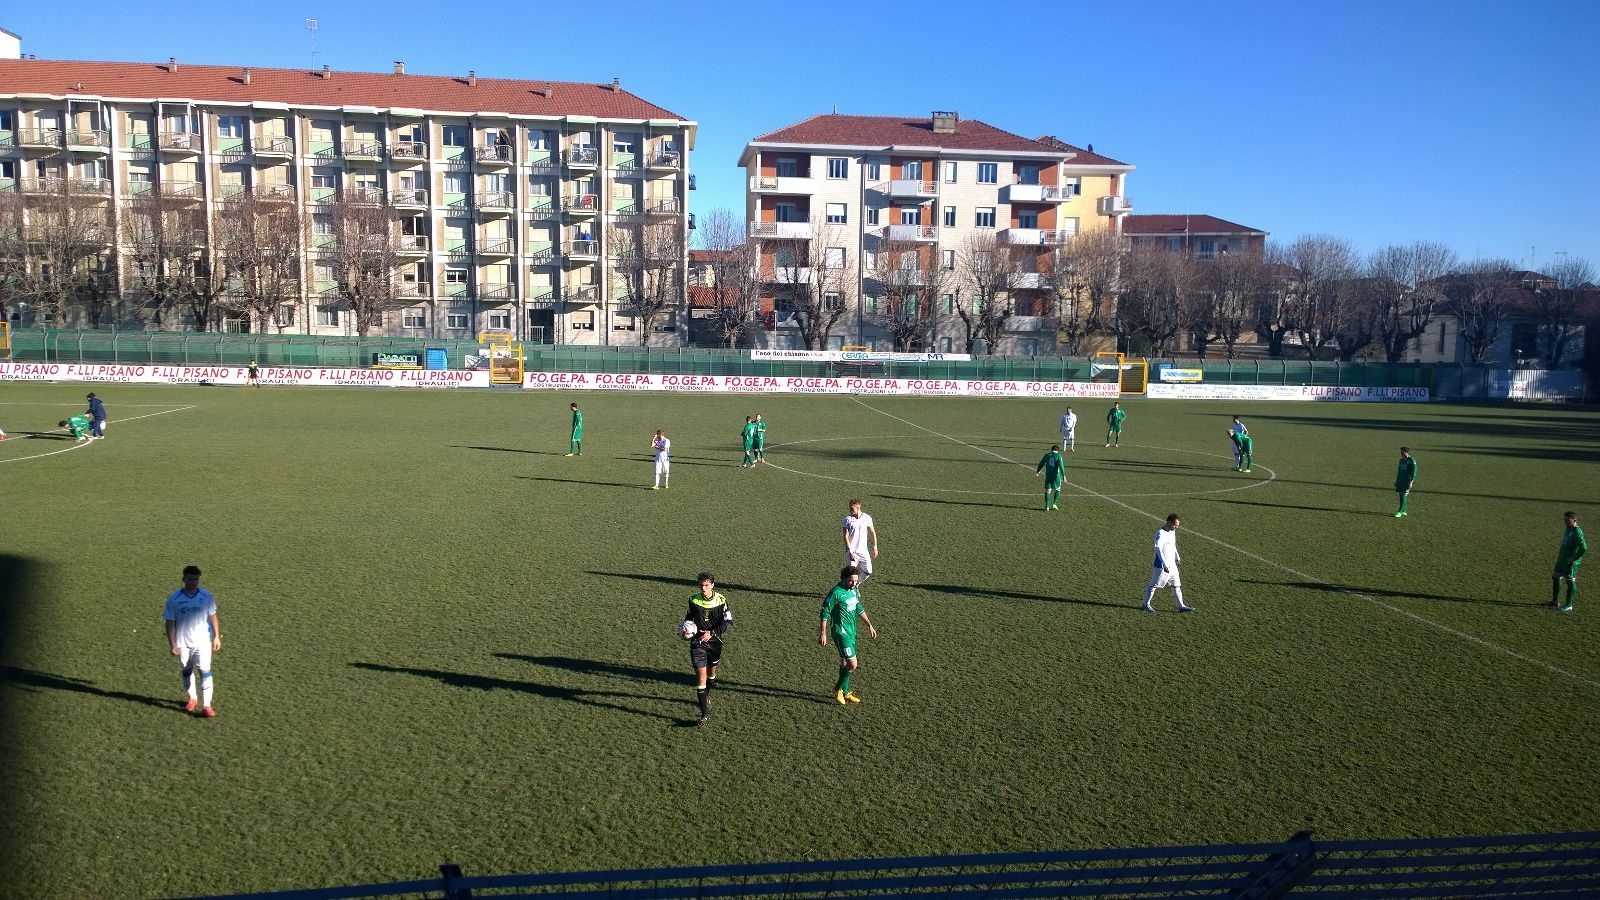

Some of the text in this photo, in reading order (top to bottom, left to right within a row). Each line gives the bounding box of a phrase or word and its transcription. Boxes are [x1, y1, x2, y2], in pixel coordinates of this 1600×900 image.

[13, 364, 60, 375] PISANO
[67, 365, 145, 377] F.LLI PISANO
[152, 367, 230, 378] F.LLI PISANO
[267, 369, 314, 379] PISANO
[319, 369, 394, 381] F.LLI PISANO
[400, 371, 474, 382] F.LLI PISANO
[530, 373, 589, 384] FO.GE.PA.
[595, 374, 653, 384] FO.GE.PA.
[662, 376, 719, 386] FO.GE.PA.
[725, 377, 781, 387] FO.GE.PA.
[787, 378, 842, 388] FO.GE.PA.
[846, 379, 902, 389] FO.GE.PA.
[907, 381, 961, 390] FO.GE.PA.
[967, 382, 1021, 391] FO.GE.PA.
[1302, 387, 1323, 396] F.LLI
[1326, 387, 1362, 397] PISANO
[1367, 388, 1427, 397] F.LLI PISANO
